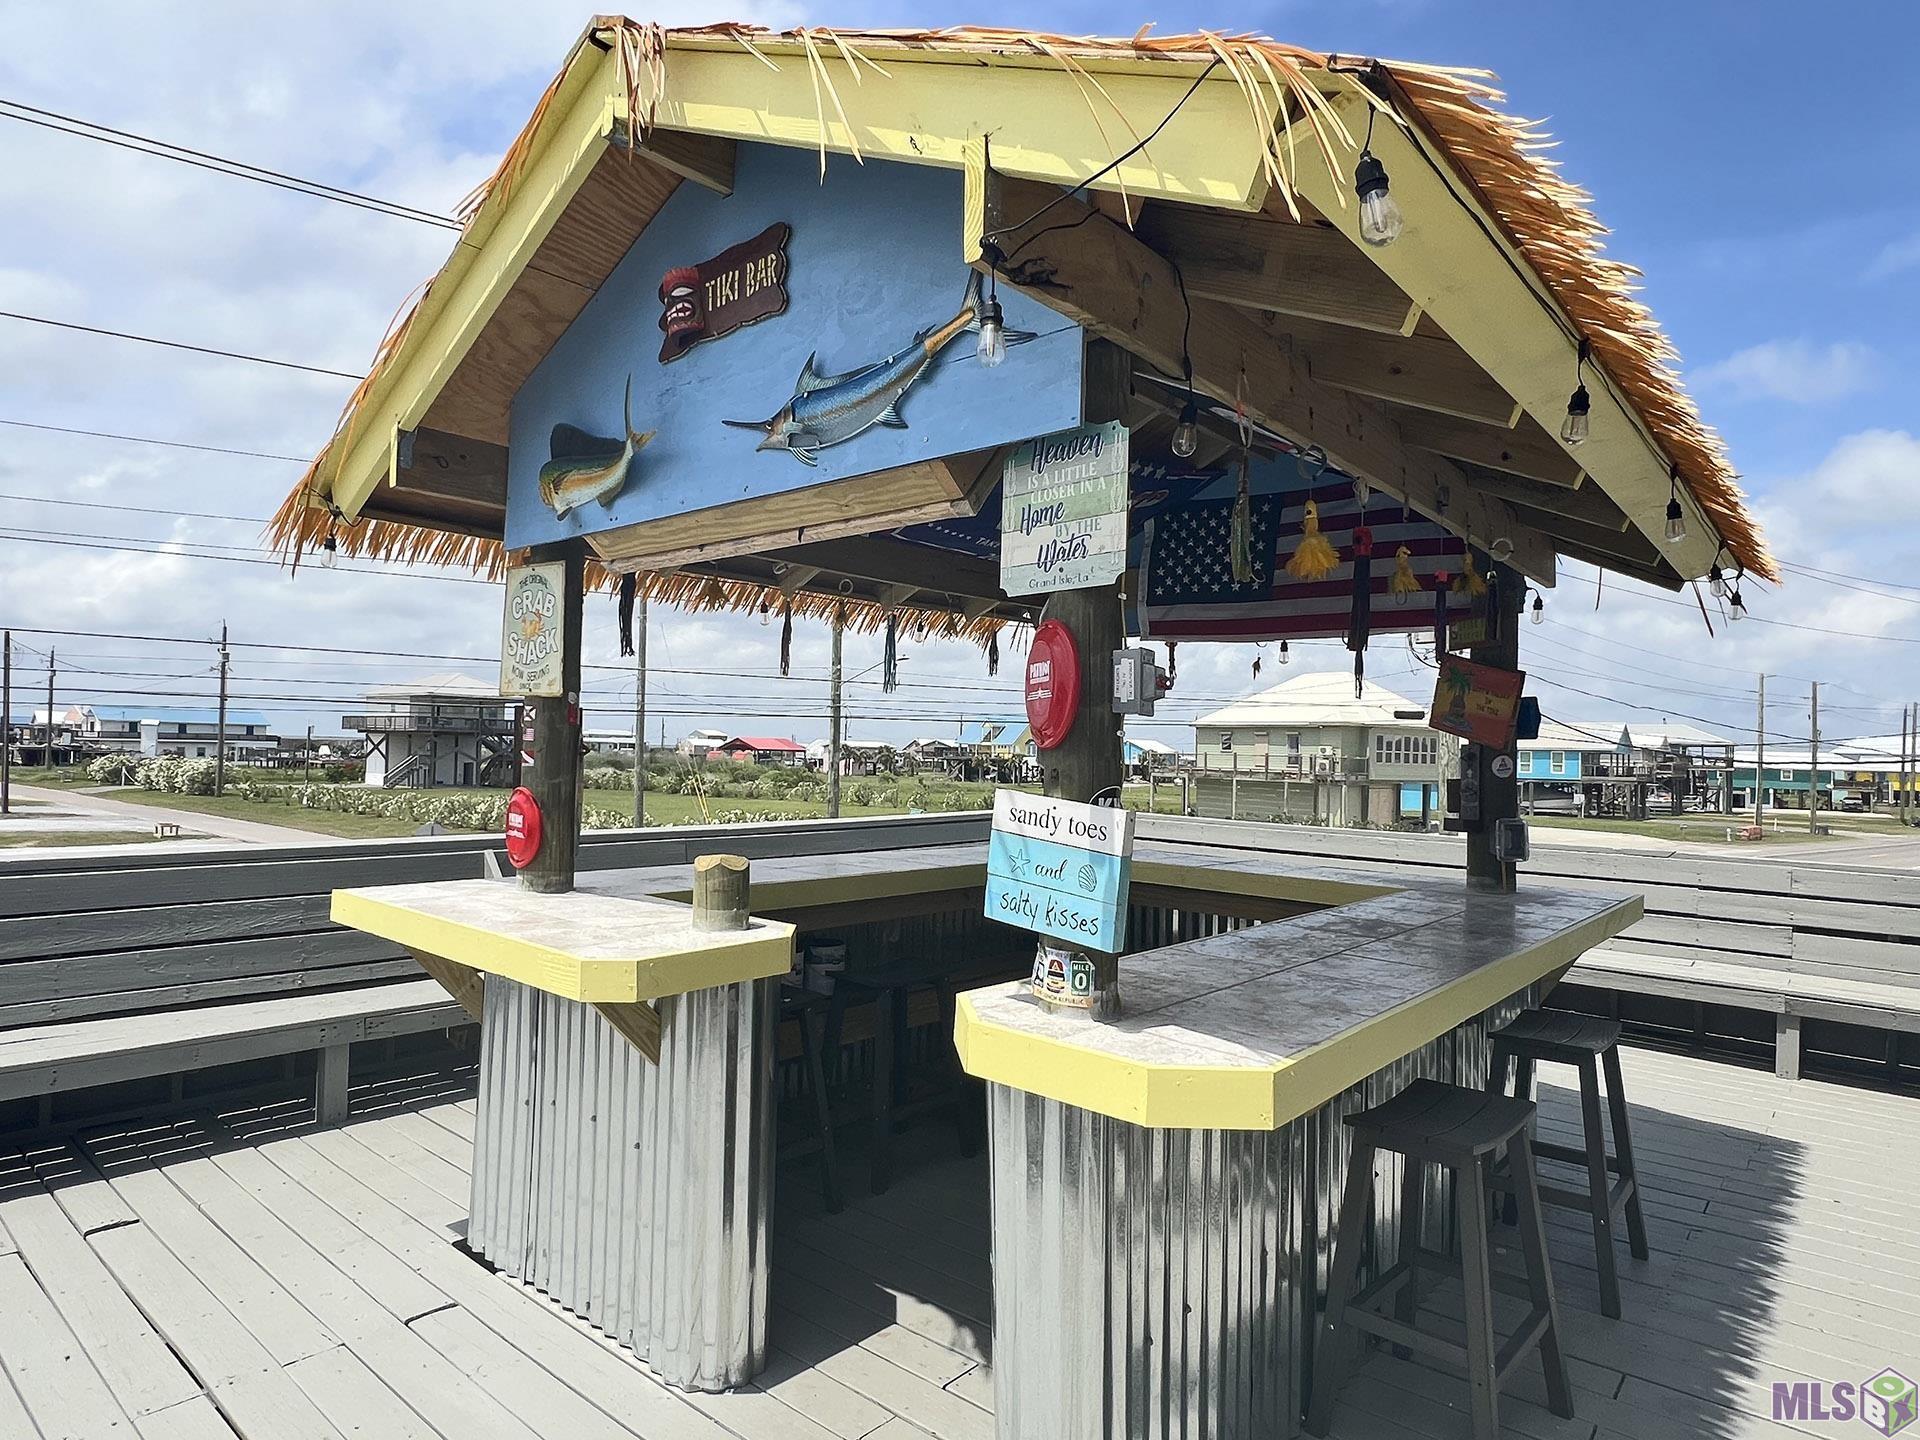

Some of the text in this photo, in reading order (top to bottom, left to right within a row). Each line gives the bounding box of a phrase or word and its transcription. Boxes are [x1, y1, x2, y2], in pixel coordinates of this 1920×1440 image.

[705, 253, 777, 312] TIKI BAR
[1030, 432, 1105, 475] Heaven
[1027, 461, 1098, 490] IS A LITTLE
[1030, 478, 1107, 504] CLOSER IN A
[1020, 501, 1065, 536] Home
[1055, 517, 1102, 538] BY THE
[1036, 533, 1092, 573] Water
[1028, 575, 1056, 589] Grand
[512, 590, 556, 620] CRAB
[507, 628, 558, 665] SHACK
[511, 664, 550, 682] NOW SERVING
[1009, 807, 1108, 841] sandy toes
[1034, 859, 1068, 882] and
[1000, 889, 1099, 936] salty kisses
[1073, 963, 1090, 971] MILE
[1074, 972, 1087, 989] 0
